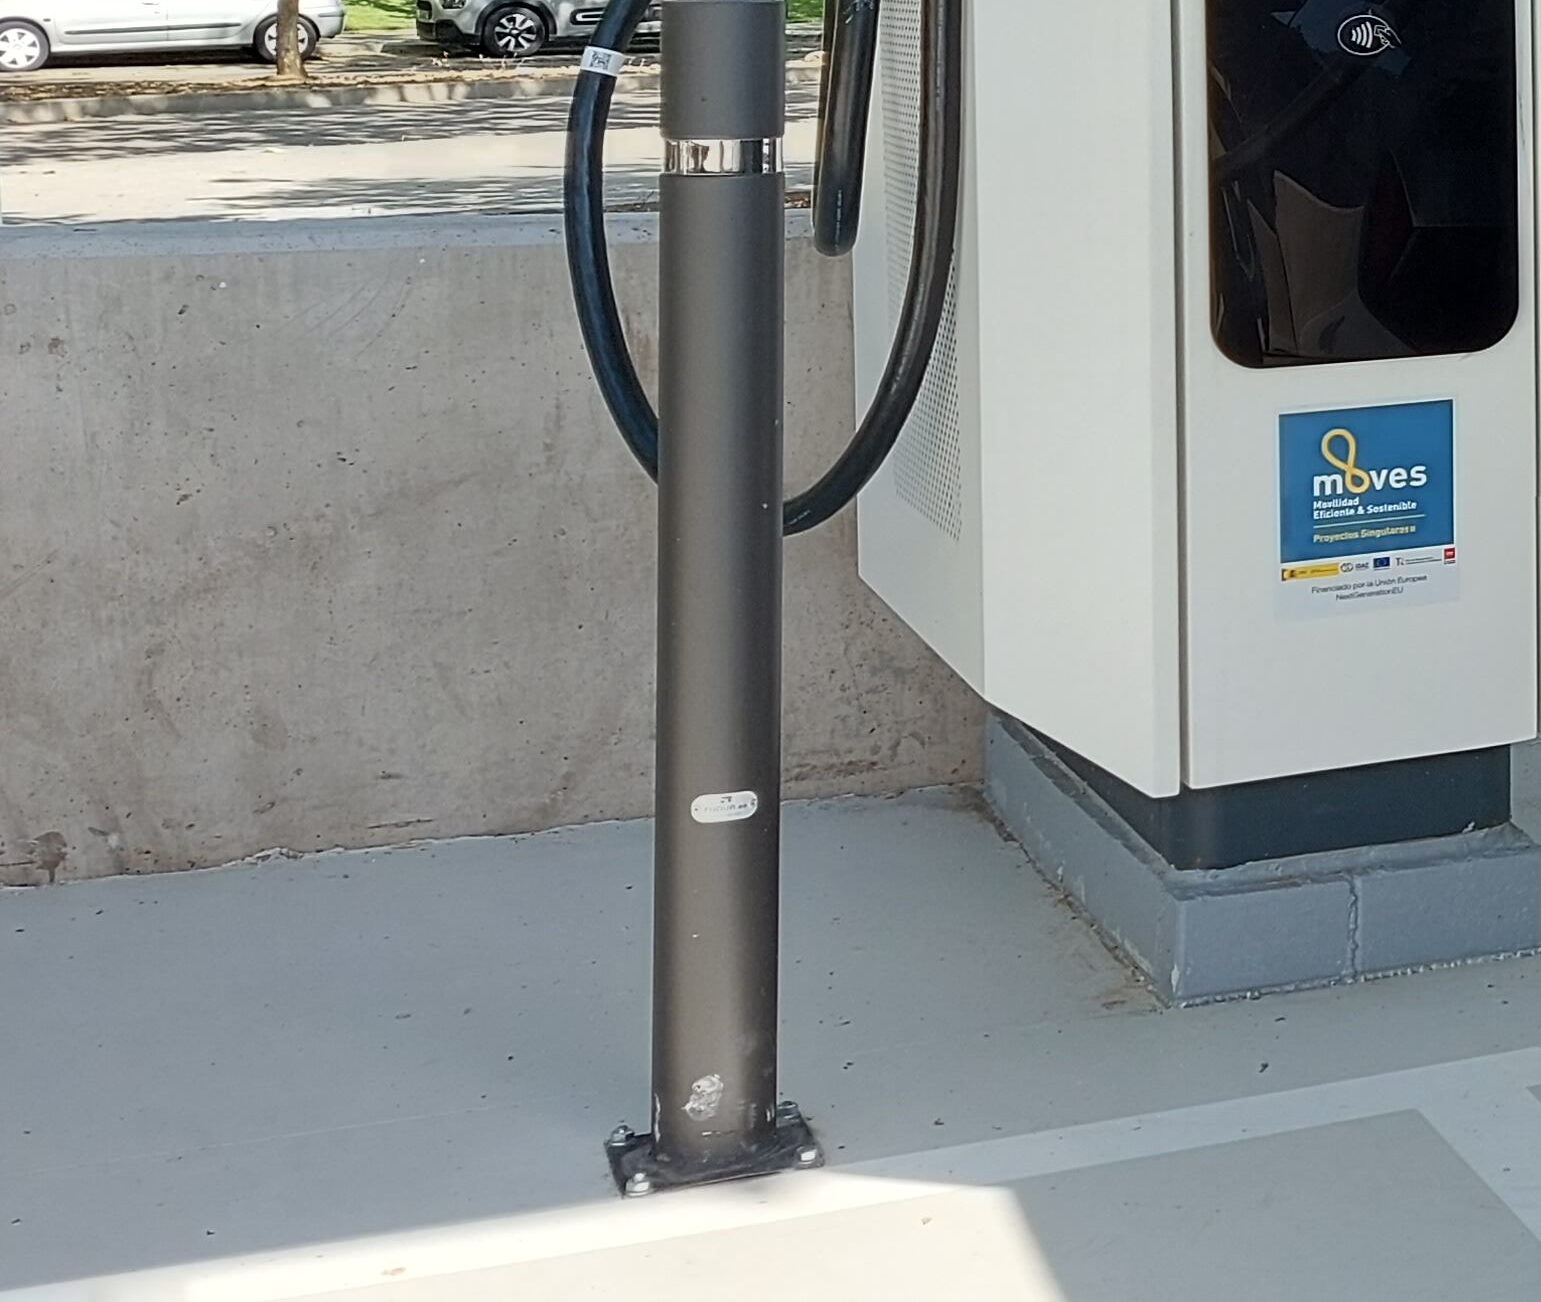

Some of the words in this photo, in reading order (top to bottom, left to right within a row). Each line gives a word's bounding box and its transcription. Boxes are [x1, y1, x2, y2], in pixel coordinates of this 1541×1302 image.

[1313, 497, 1359, 509] Movilidad
[1313, 508, 1355, 519] Eficiente
[1357, 505, 1364, 515] &
[1367, 501, 1417, 514] Sostenible
[1311, 583, 1352, 594] Financiado
[1352, 582, 1365, 592] por
